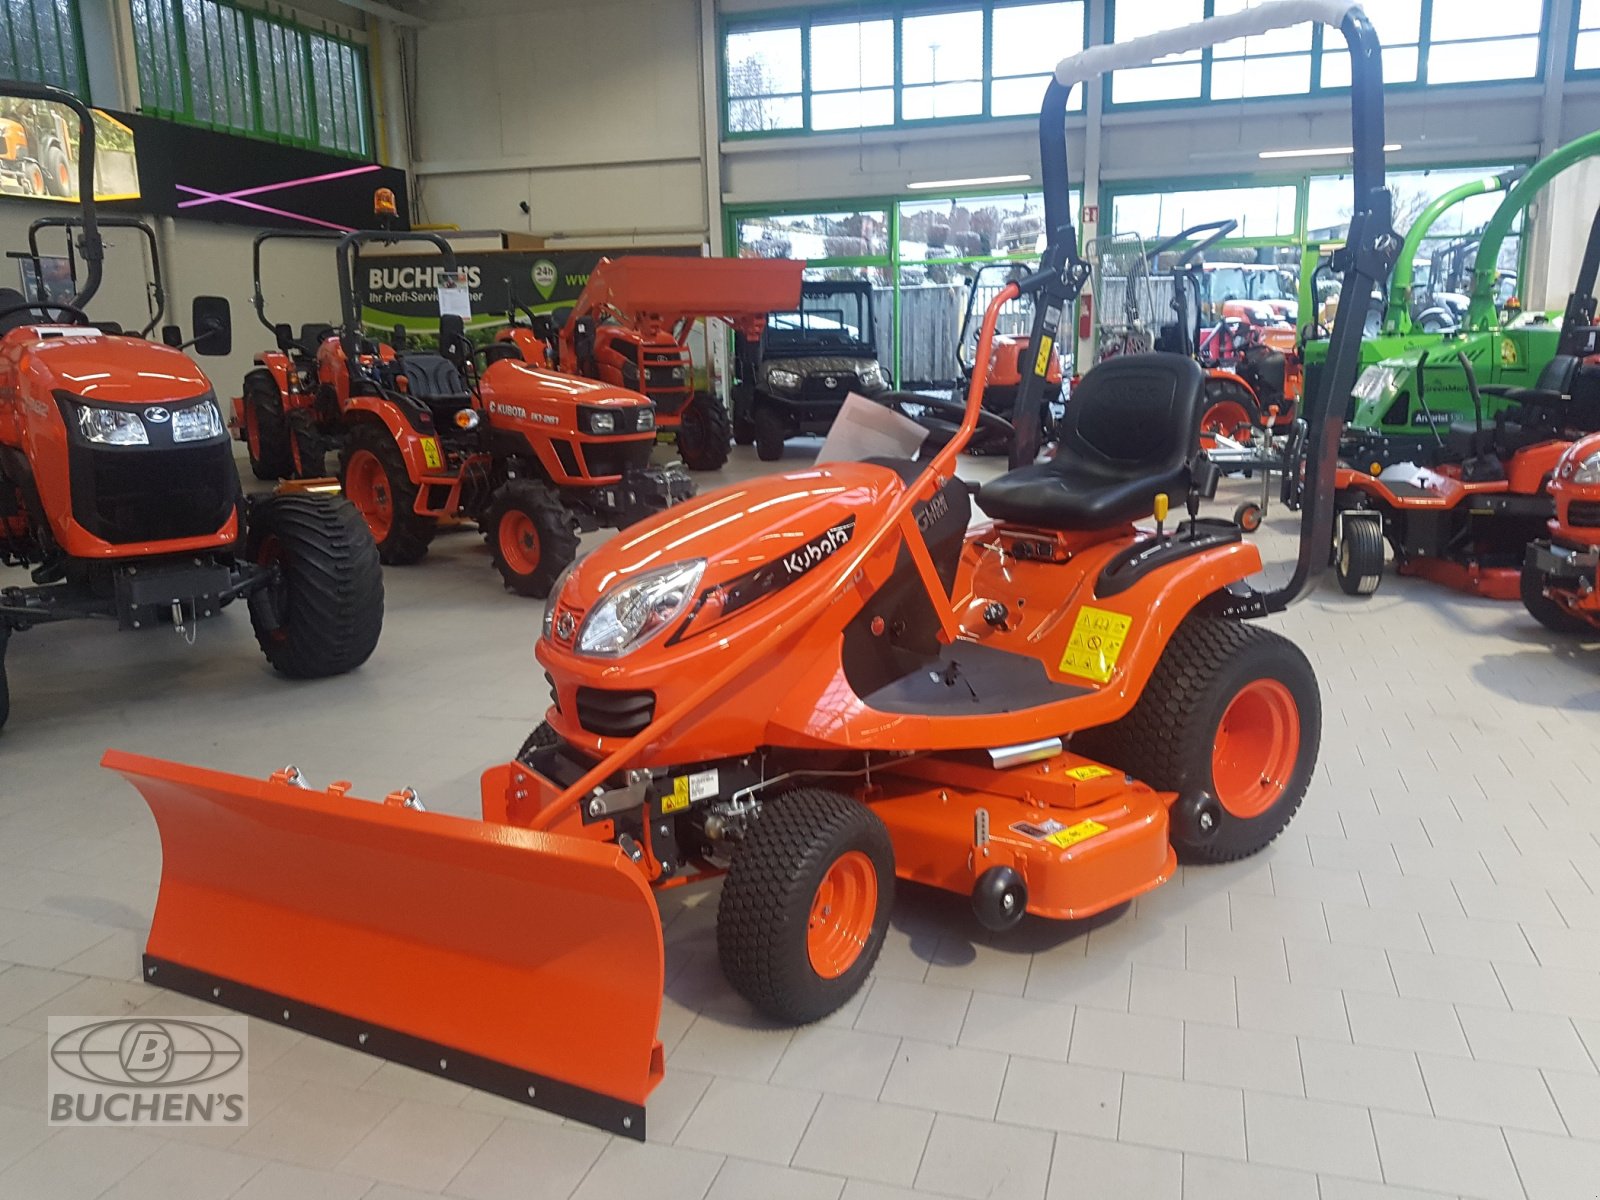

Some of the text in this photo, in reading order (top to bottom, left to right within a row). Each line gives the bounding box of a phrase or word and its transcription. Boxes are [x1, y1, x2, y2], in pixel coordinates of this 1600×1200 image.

[369, 266, 481, 289] BUCHE'S
[369, 293, 382, 303] Ihr
[497, 403, 527, 419] KUBOTA
[782, 530, 849, 574] Kubota
